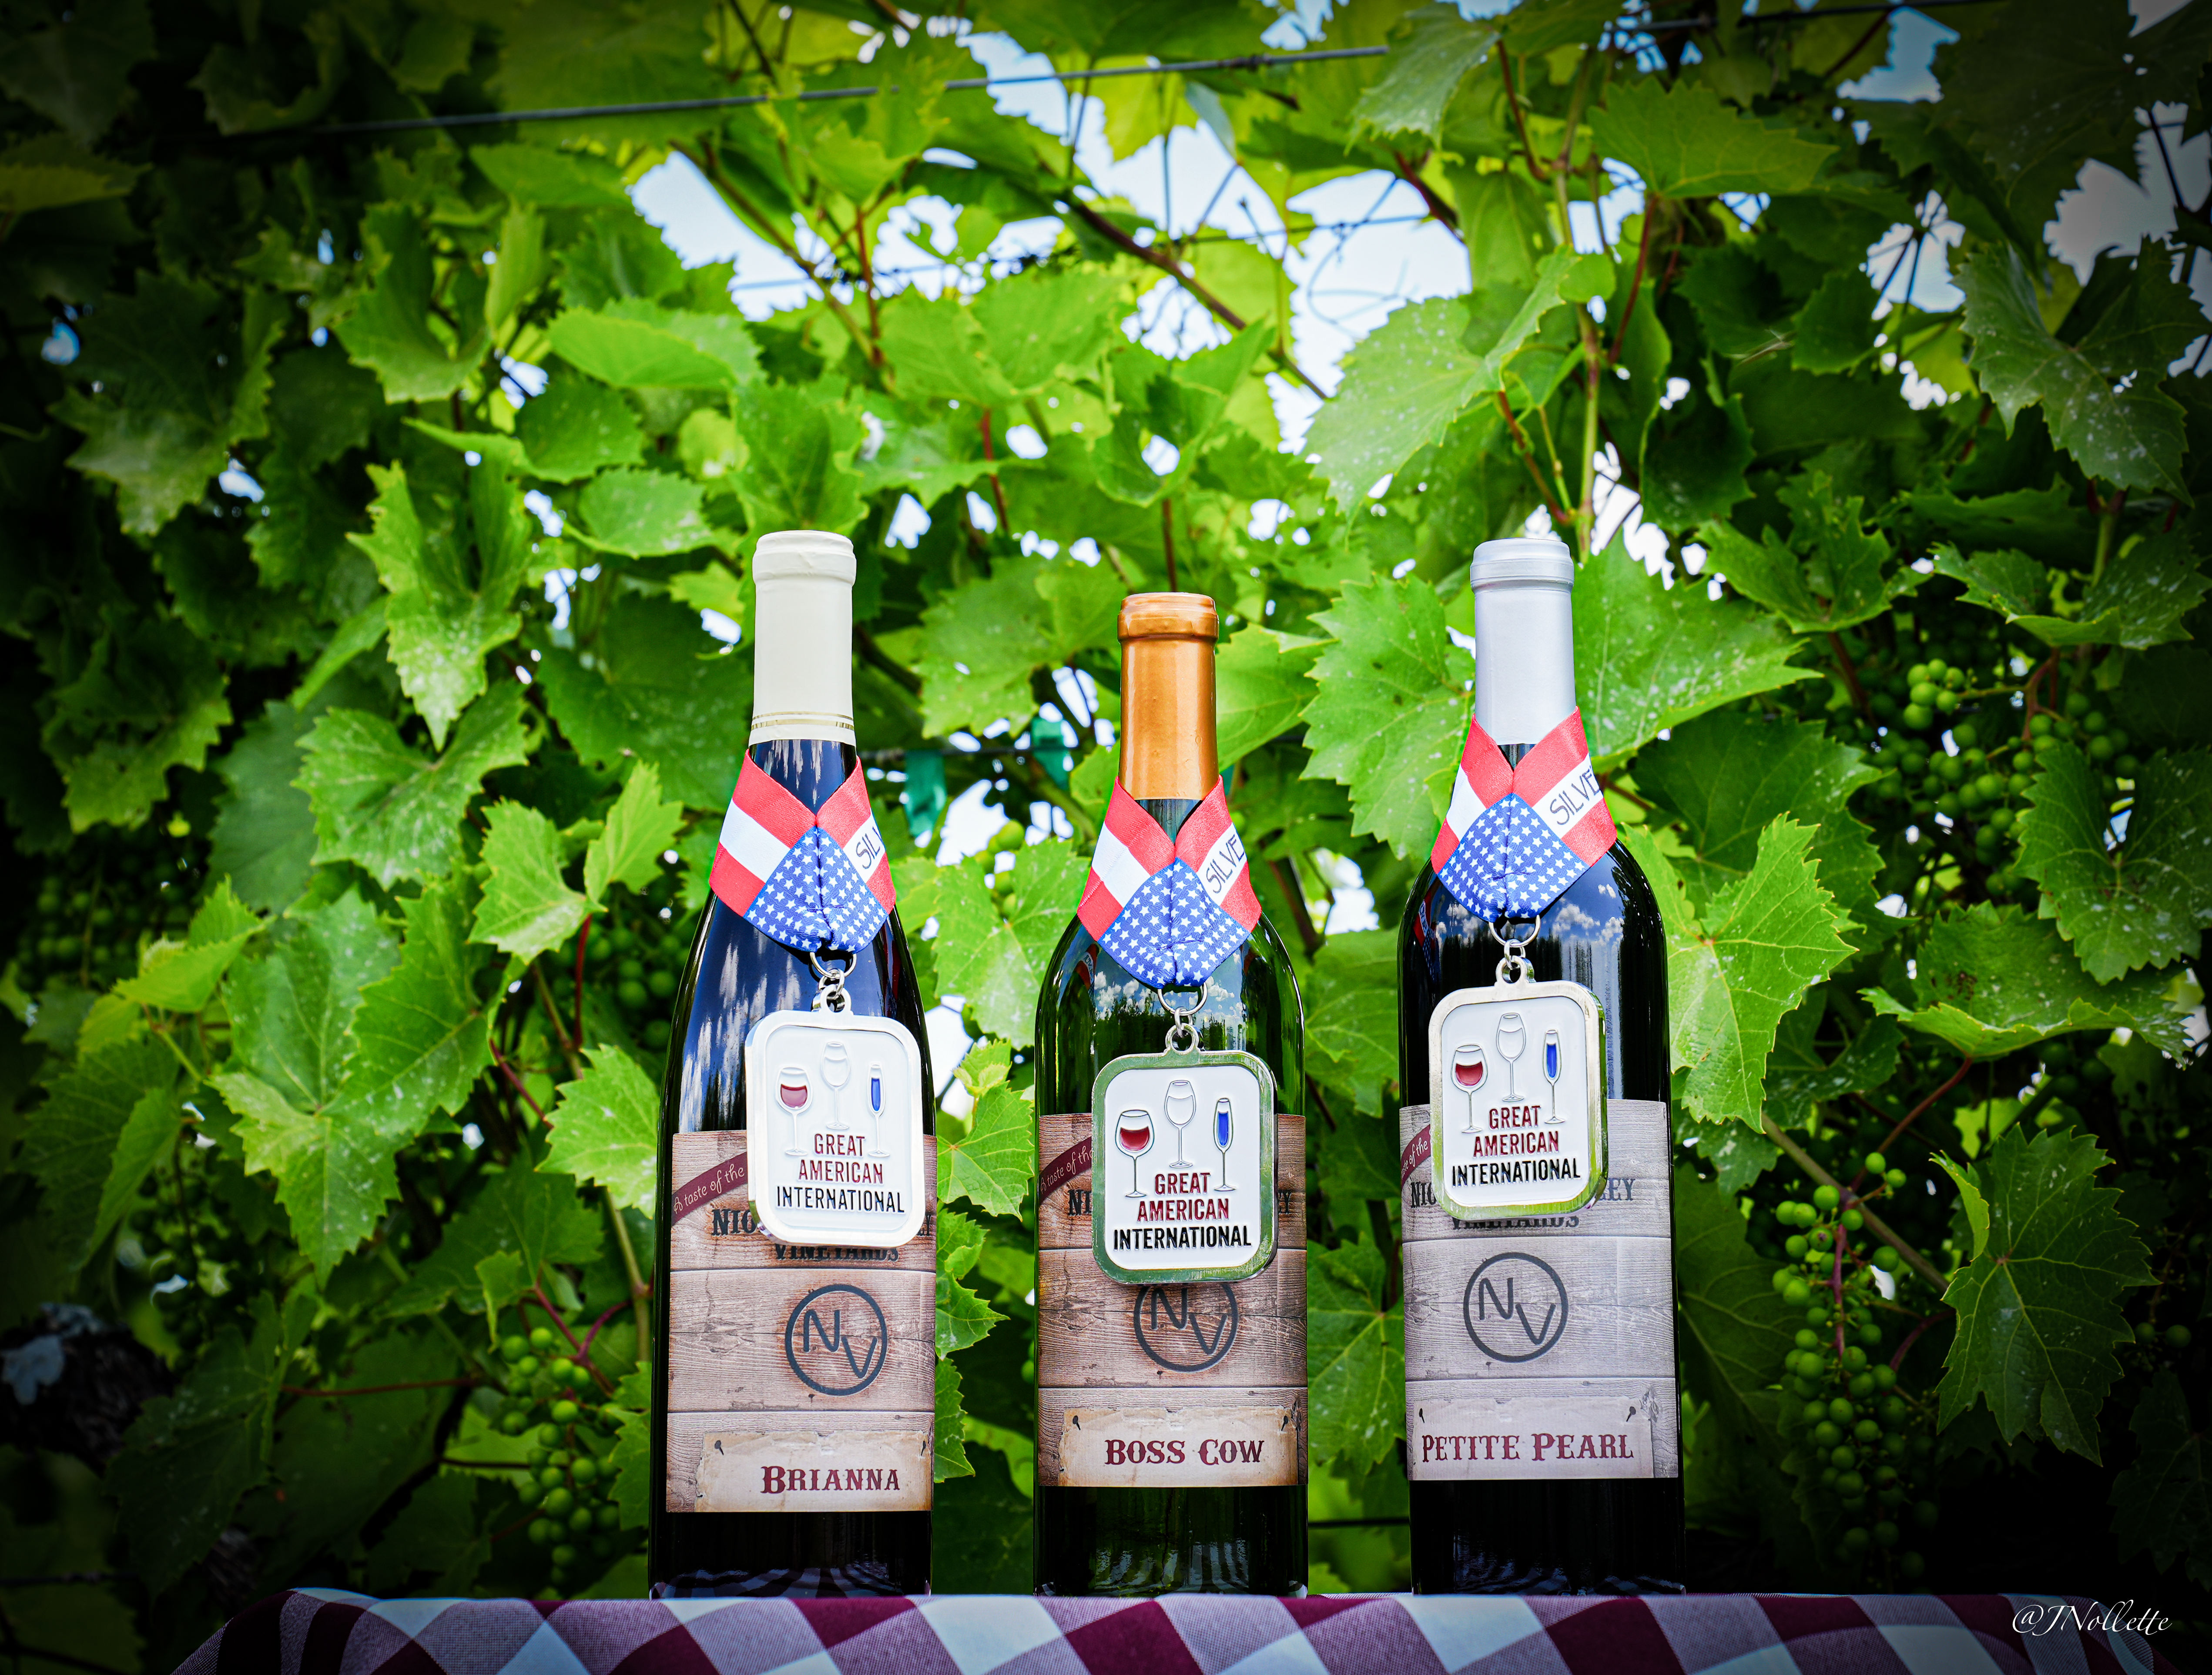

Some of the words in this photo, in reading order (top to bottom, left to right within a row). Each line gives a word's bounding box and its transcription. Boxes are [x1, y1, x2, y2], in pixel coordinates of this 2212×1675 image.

[1550, 766, 1600, 825] SILVE
[1207, 834, 1244, 893] SILVE
[1489, 1105, 1541, 1130] GREAT
[814, 1134, 865, 1156] GREAT
[1409, 1144, 1415, 1167] of
[1416, 1137, 1428, 1156] the
[1472, 1131, 1559, 1158] AMERICAN
[799, 1160, 883, 1184] AMERICAN
[1047, 1167, 1064, 1186] taste
[1066, 1152, 1076, 1175] of
[1452, 1158, 1581, 1188] INTERNATIONAL
[674, 1197, 683, 1214] A
[684, 1186, 707, 1206] taste
[710, 1170, 722, 1194] of
[724, 1163, 744, 1183] the
[1155, 1172, 1211, 1195] GREAT
[777, 1186, 905, 1213] INTERNATIONAL
[1137, 1198, 1229, 1222] AMERICAN
[1113, 1225, 1251, 1251] INTERNATIONAL
[1104, 1439, 1185, 1465] BOSS
[1198, 1439, 1265, 1465] COW
[1422, 1434, 1520, 1463] PETITE
[1531, 1433, 1635, 1461] PEARL
[761, 1466, 900, 1494] BRIANNA
